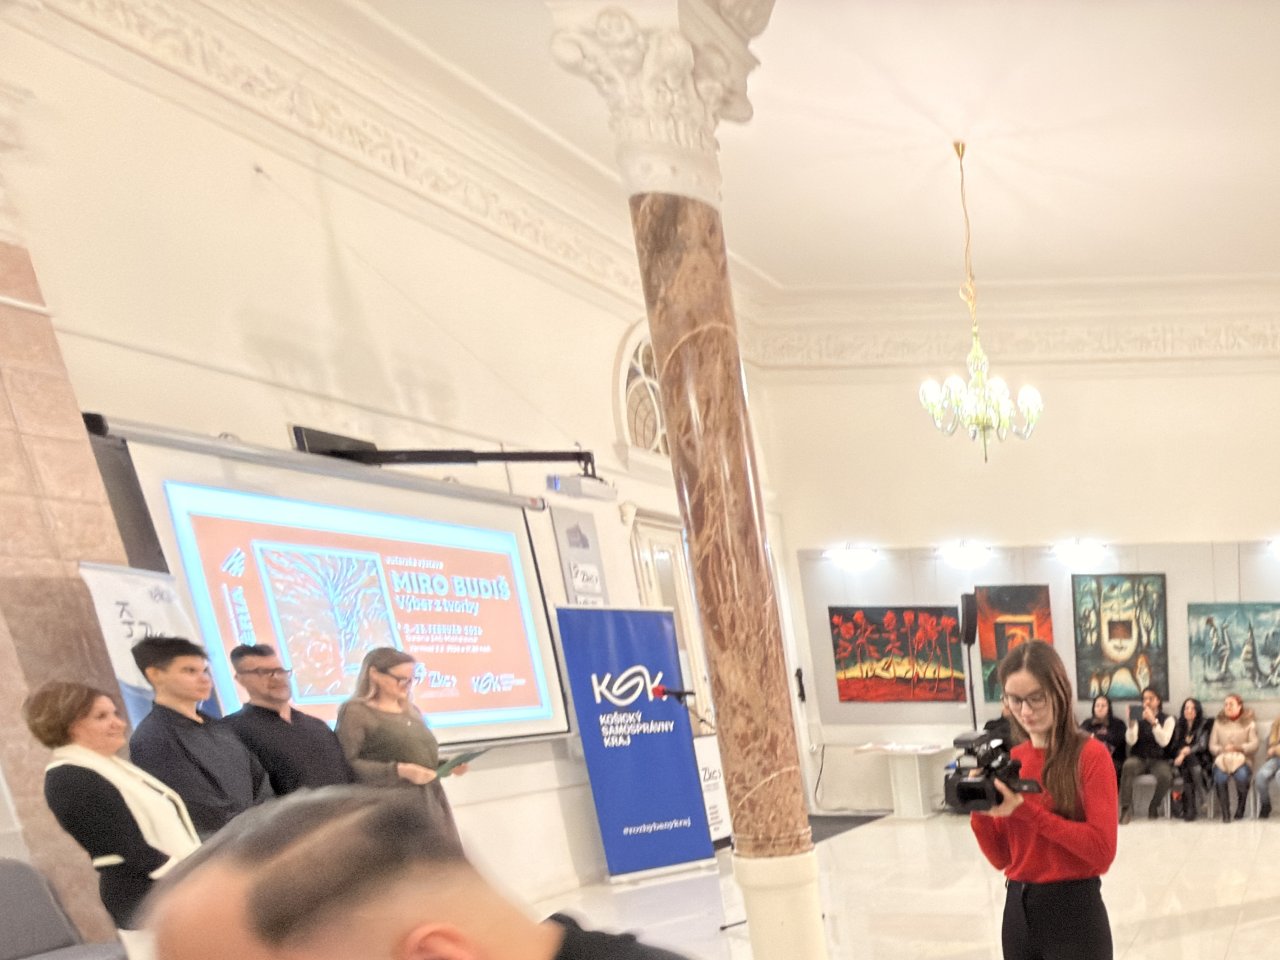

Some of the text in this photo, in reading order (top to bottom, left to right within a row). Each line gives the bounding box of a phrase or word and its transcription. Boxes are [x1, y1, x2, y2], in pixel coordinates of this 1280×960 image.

[390, 570, 511, 600] MIRO BUDIŠ
[591, 665, 668, 706] KSK
[599, 710, 642, 726] KOŠICKÝ
[601, 720, 674, 737] SAMOSPRÁVNY
[603, 735, 631, 748] KRAJ
